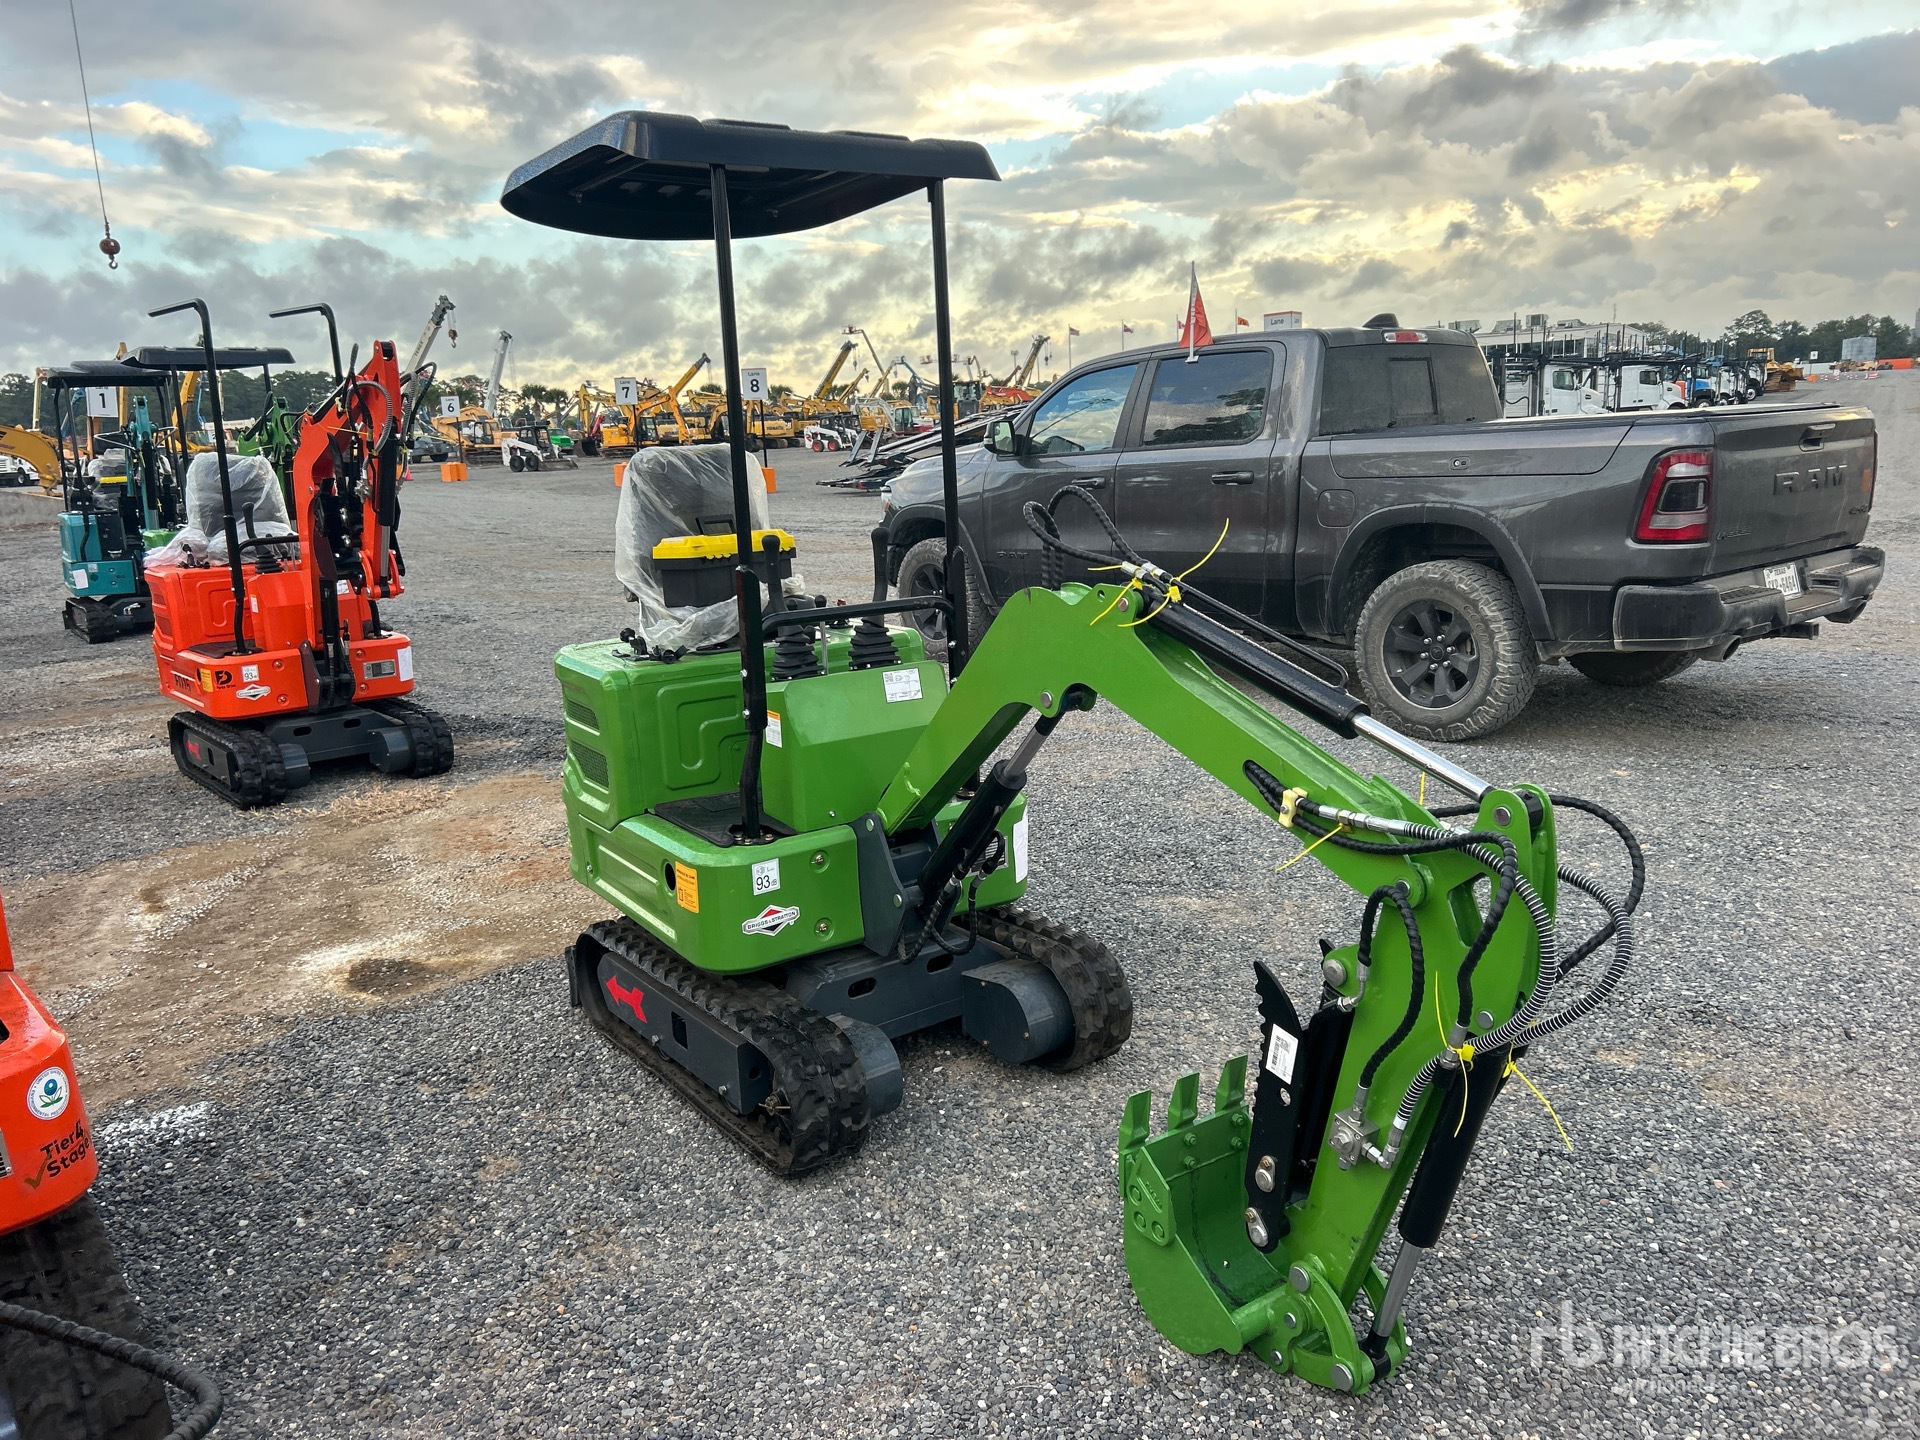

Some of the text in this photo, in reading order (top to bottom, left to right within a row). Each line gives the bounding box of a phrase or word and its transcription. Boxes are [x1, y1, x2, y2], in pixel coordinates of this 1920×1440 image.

[622, 386, 630, 399] 7
[750, 379, 760, 393] 8
[98, 392, 106, 409] 1
[447, 403, 455, 413] 6
[1772, 464, 1848, 496] RAM
[244, 672, 254, 681] 93
[756, 874, 771, 891] 93
[46, 1137, 90, 1178] Stage
